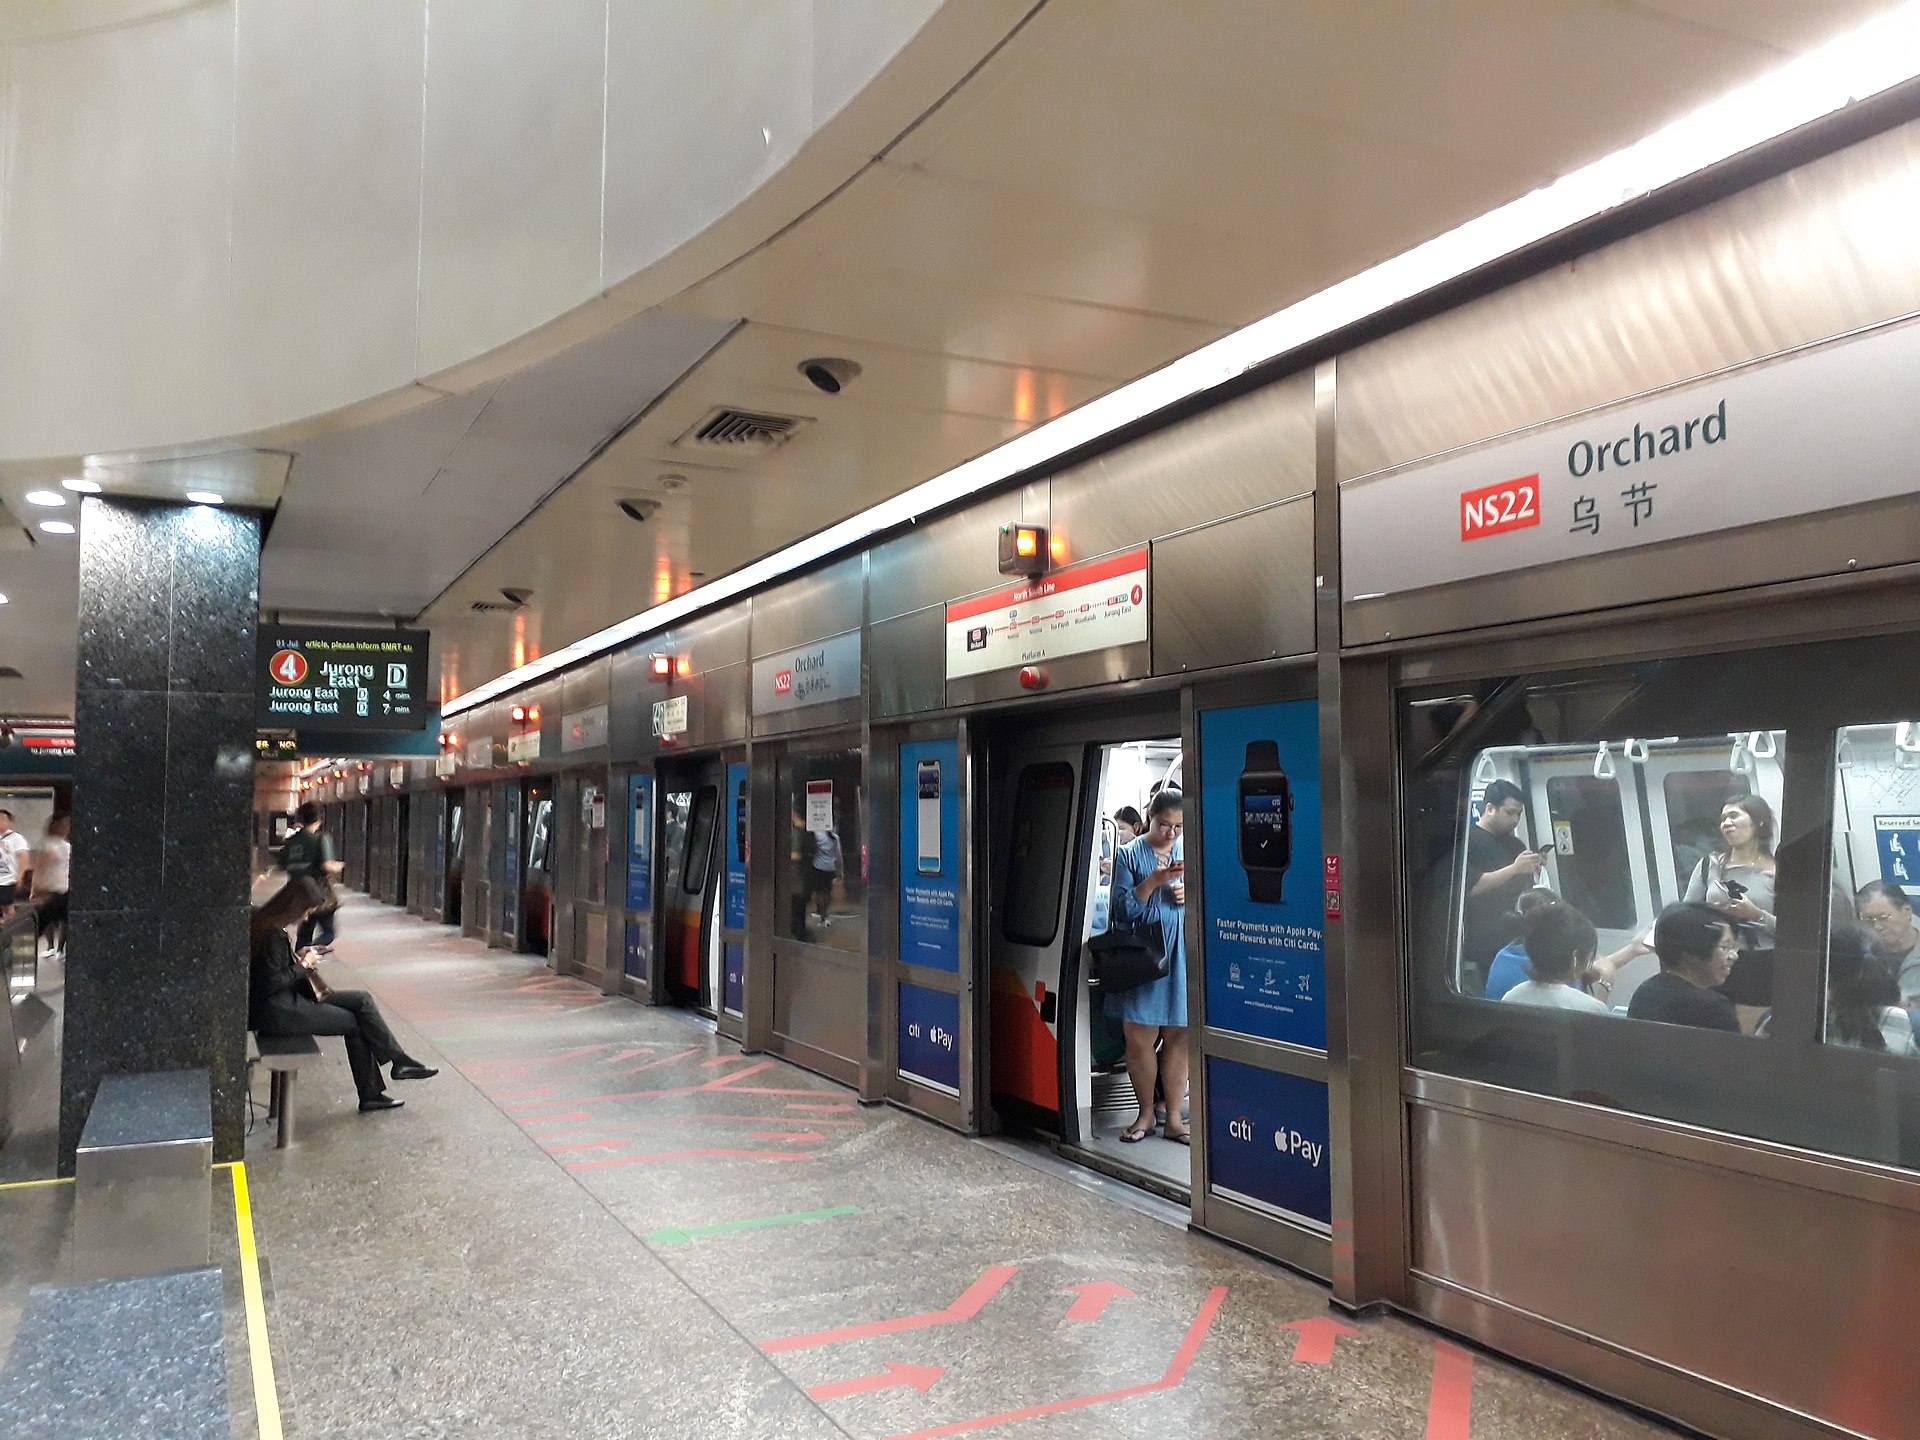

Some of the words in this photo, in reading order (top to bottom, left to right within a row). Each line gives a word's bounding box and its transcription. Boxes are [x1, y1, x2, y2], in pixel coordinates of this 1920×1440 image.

[1568, 398, 1727, 477] Orchard
[1464, 485, 1536, 532] NS22
[1569, 481, 1658, 535] 乌节
[1013, 589, 1028, 602] North
[1043, 582, 1056, 594] Line
[331, 642, 355, 651] please
[380, 643, 402, 652] SMRT
[279, 654, 296, 681] 4
[319, 660, 374, 680] Jurong
[795, 649, 825, 673] Orchard
[329, 673, 360, 688] East
[269, 686, 312, 701] Jurong
[314, 686, 340, 699] East
[382, 690, 391, 701] 4
[269, 700, 312, 715] Jurong
[314, 700, 340, 713] East
[382, 703, 391, 715] 7
[394, 706, 410, 714] mins
[1216, 918, 1237, 928] Faster
[1237, 920, 1270, 932] Payments
[1269, 924, 1286, 934] with
[1286, 926, 1307, 937] Apple
[1307, 927, 1323, 940] Pay.
[1219, 930, 1239, 941] Faster
[1239, 932, 1268, 945] Rewards
[1267, 936, 1284, 947] with
[1283, 937, 1297, 948] Citi
[1297, 940, 1321, 951] Cards.
[908, 1023, 920, 1038] citi
[937, 1027, 953, 1051] Pay
[1229, 1119, 1252, 1142] citi
[1290, 1130, 1322, 1168] Pay
